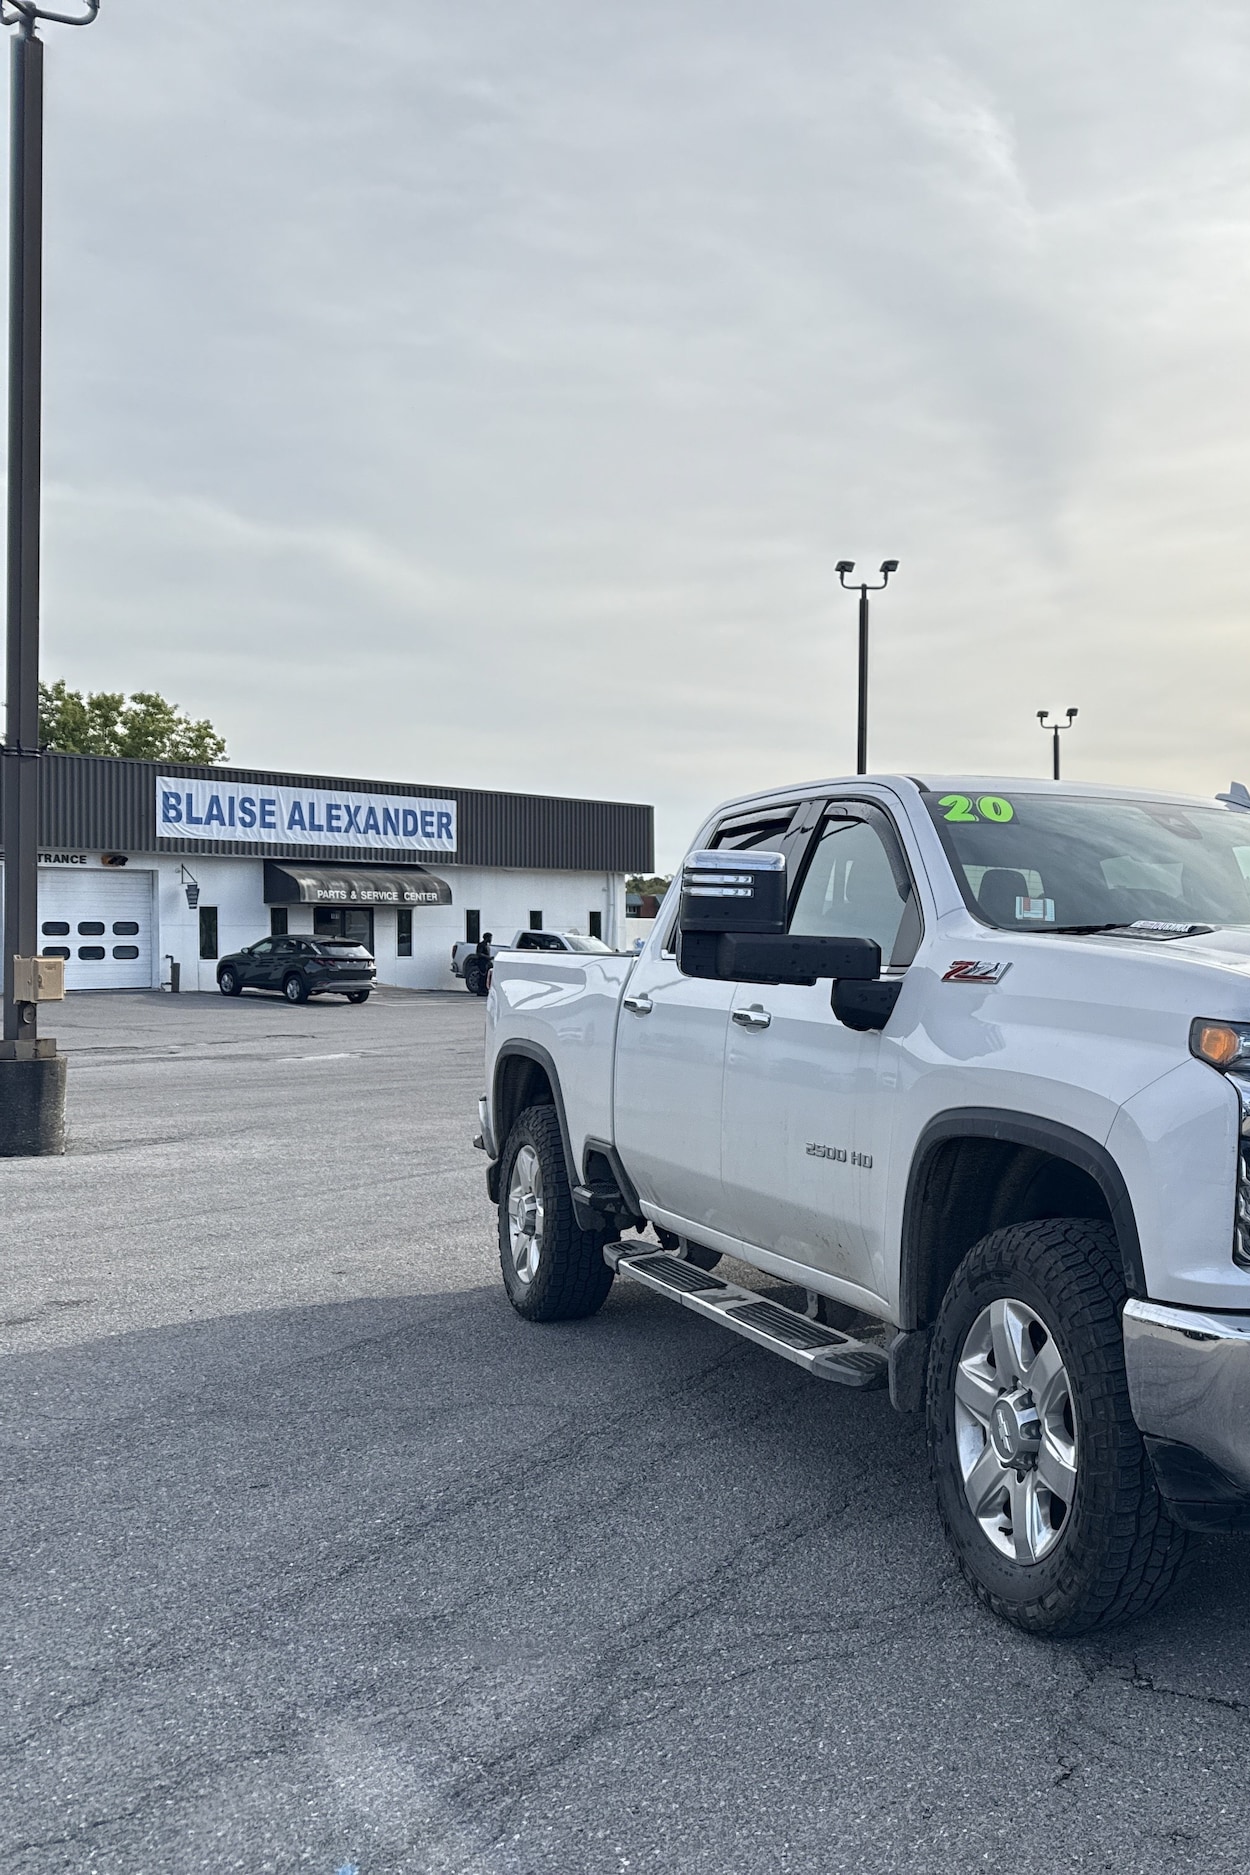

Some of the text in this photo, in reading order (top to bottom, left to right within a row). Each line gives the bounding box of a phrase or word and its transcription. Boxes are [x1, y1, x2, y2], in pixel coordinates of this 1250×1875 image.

[162, 791, 453, 840] BLAISE ALEXANDER
[938, 794, 1014, 823] 20
[37, 853, 87, 865] TRANCE
[317, 890, 438, 901] PARTS & SERVICE CENTER
[941, 960, 1014, 985] Z71
[805, 1141, 873, 1169] 2500 HD
